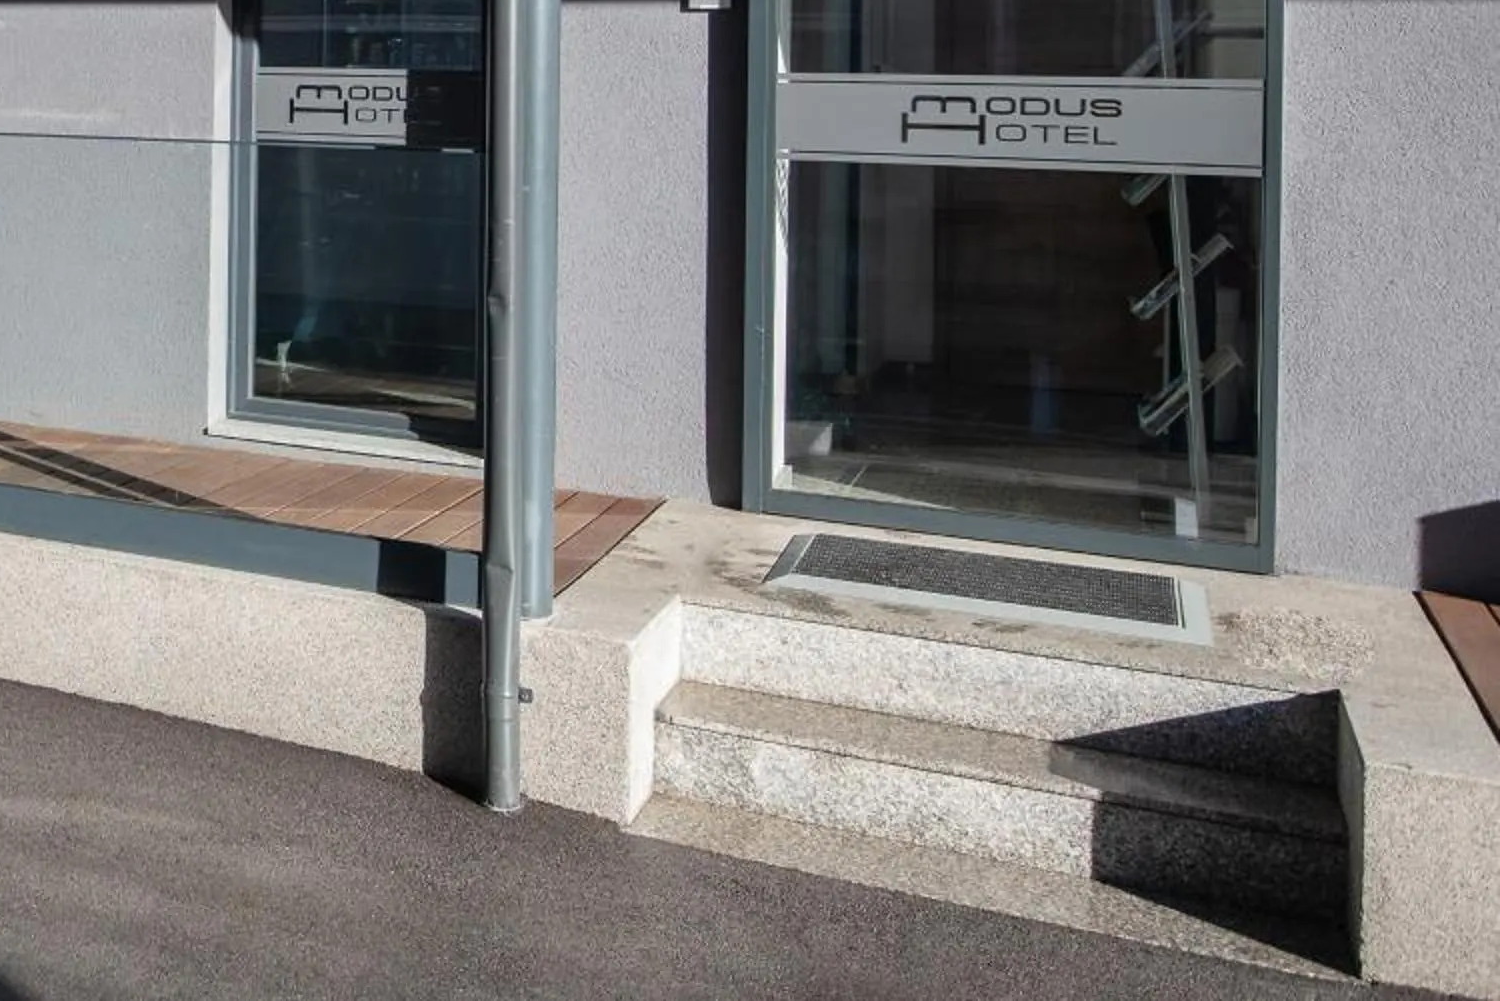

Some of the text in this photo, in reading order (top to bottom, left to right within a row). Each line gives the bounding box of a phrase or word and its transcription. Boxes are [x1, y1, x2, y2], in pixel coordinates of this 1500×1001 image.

[296, 84, 409, 102] MODU
[289, 98, 409, 125] HOT
[911, 94, 1123, 118] MODUS
[902, 112, 1118, 145] HOTEL
